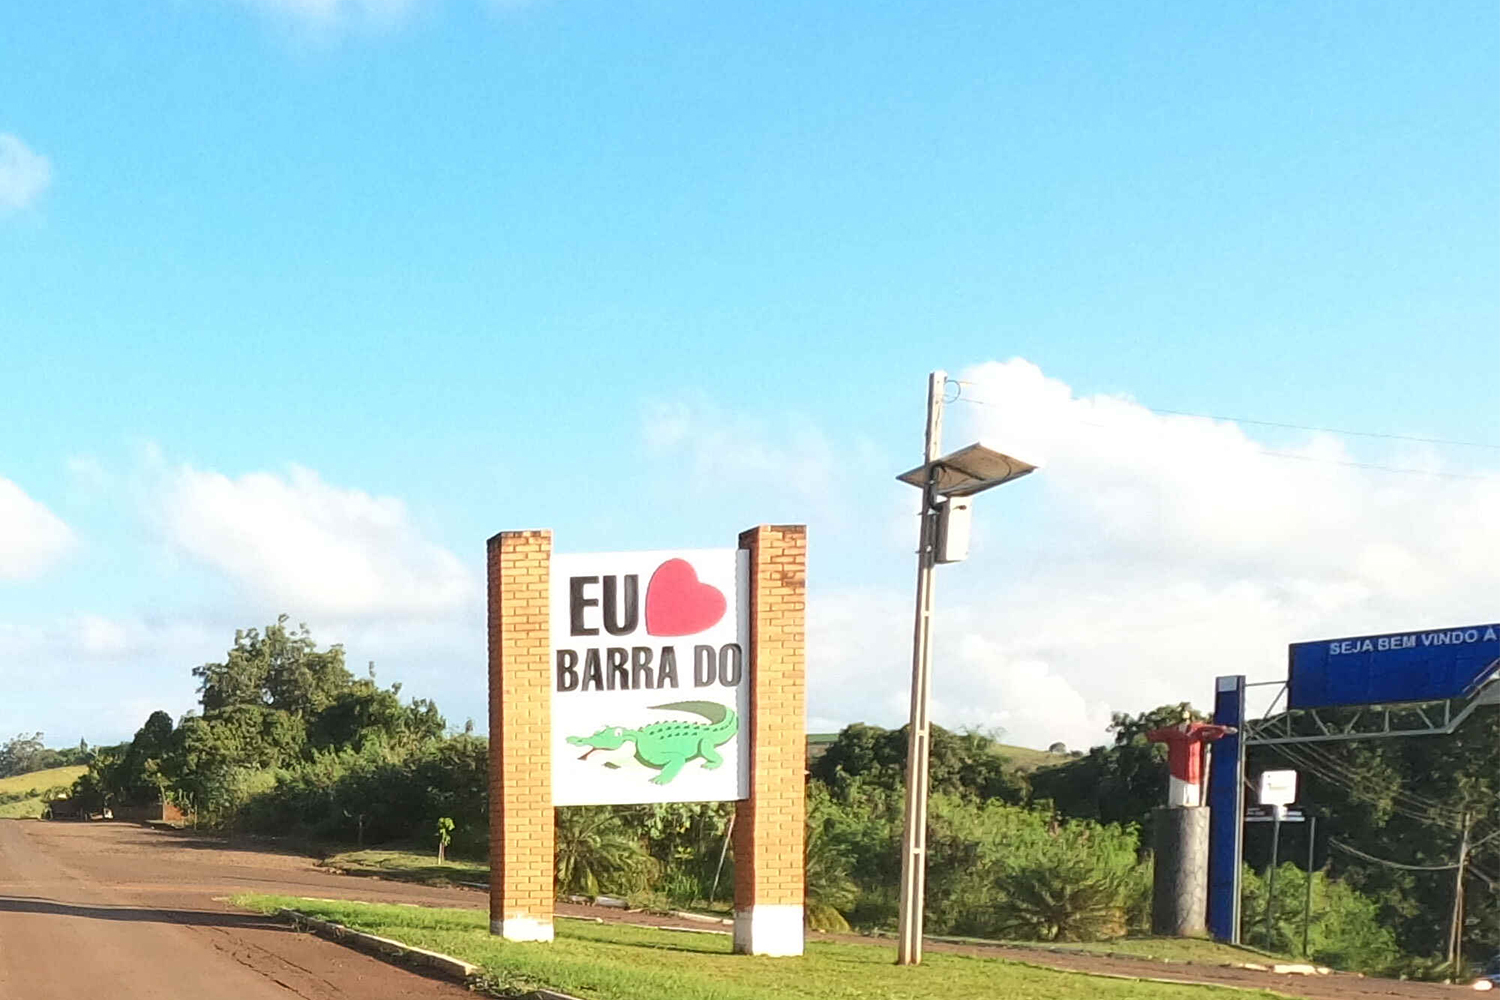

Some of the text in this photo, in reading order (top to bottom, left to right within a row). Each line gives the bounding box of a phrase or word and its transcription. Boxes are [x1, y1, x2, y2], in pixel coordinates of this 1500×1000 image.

[570, 574, 639, 637] EU
[1330, 641, 1373, 655] SEJA
[1378, 634, 1417, 651] BEM
[1421, 630, 1478, 647] VINDO
[556, 643, 743, 692] BARRA DO
